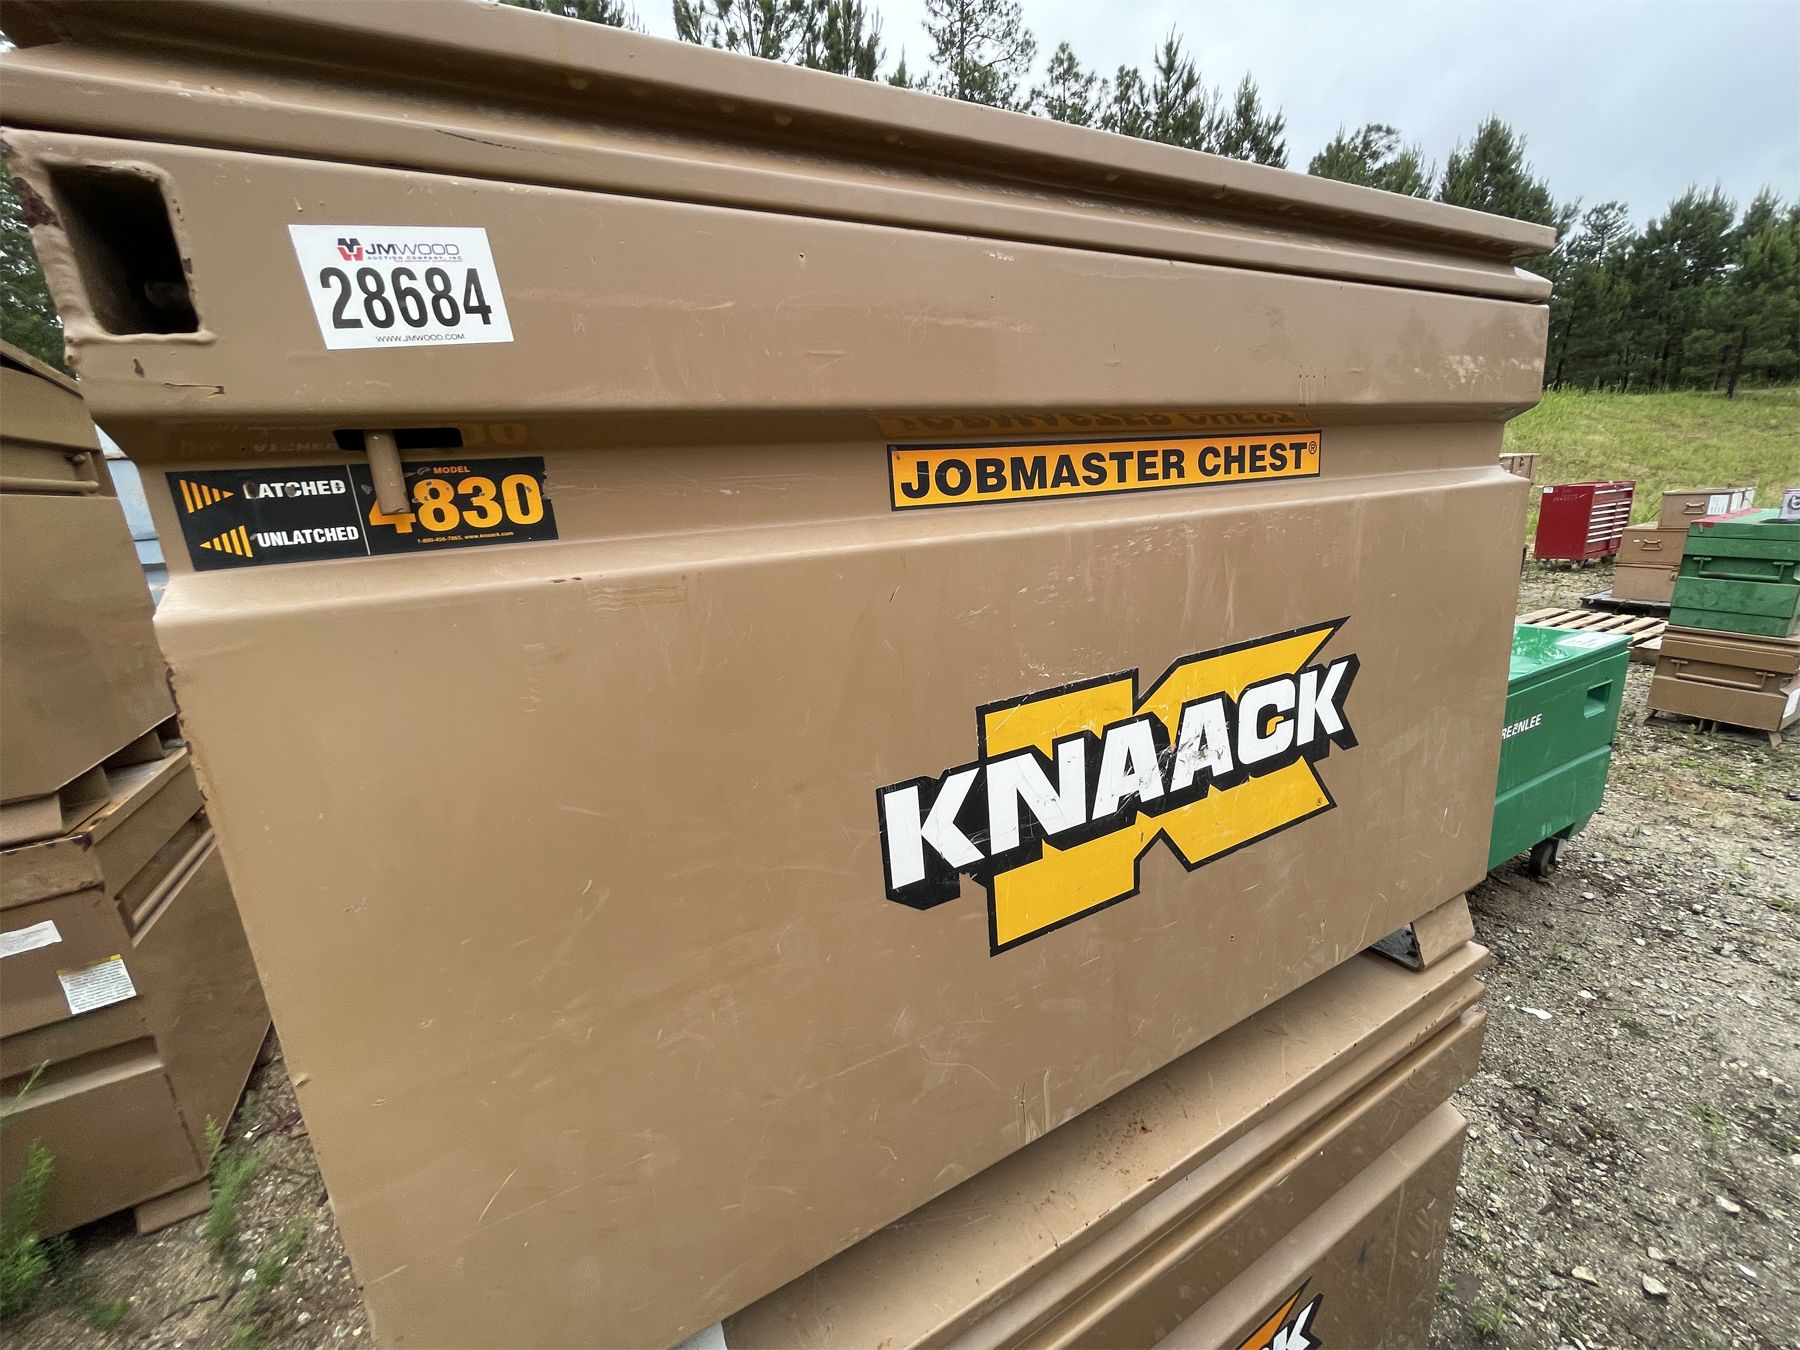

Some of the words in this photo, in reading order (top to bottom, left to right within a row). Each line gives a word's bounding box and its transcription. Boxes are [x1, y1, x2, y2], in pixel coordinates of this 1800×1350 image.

[365, 243, 459, 255] JMWOOD
[320, 267, 492, 329] 28684
[375, 333, 466, 343] WWW.JMWOOD.COM
[433, 465, 471, 475] MODEL
[901, 450, 1186, 499] JOBMASTER
[369, 474, 544, 534] 4830
[256, 525, 360, 548] UNLATCHED
[1501, 713, 1543, 740] REENLEE
[883, 659, 1349, 891] KNAACK
